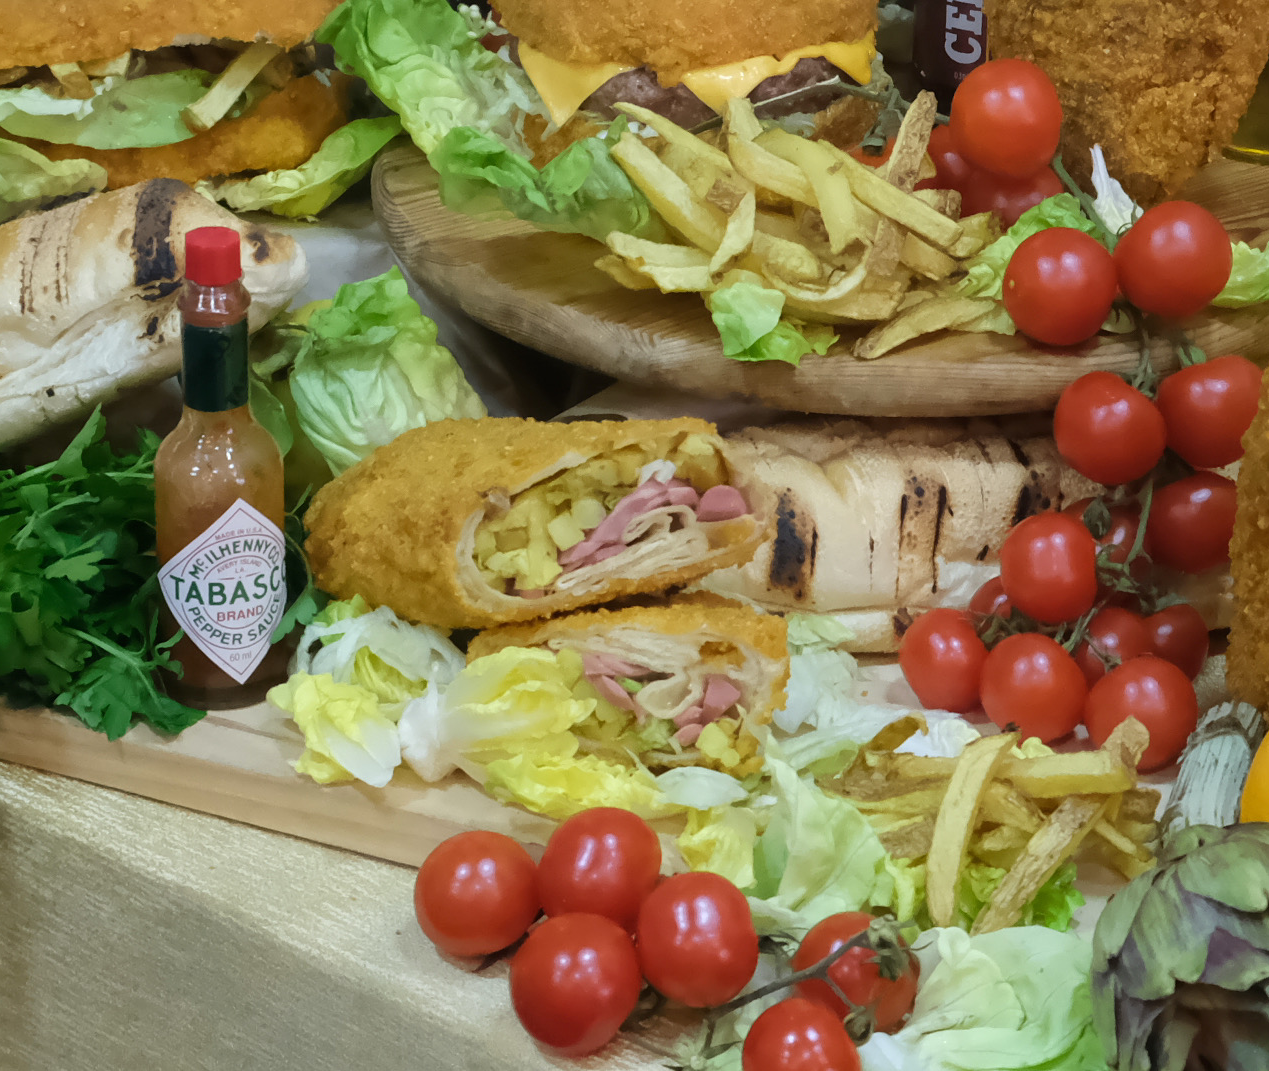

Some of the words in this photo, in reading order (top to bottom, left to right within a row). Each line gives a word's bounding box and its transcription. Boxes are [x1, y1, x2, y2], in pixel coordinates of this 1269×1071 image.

[214, 529, 236, 542] MADE
[216, 559, 238, 574] AVERY
[239, 558, 263, 568] ISLAND
[188, 605, 244, 646] PEPPER
[247, 592, 281, 642] SAUCE
[216, 604, 265, 623] BRAND
[229, 651, 241, 663] 60
[241, 650, 253, 662] ml
